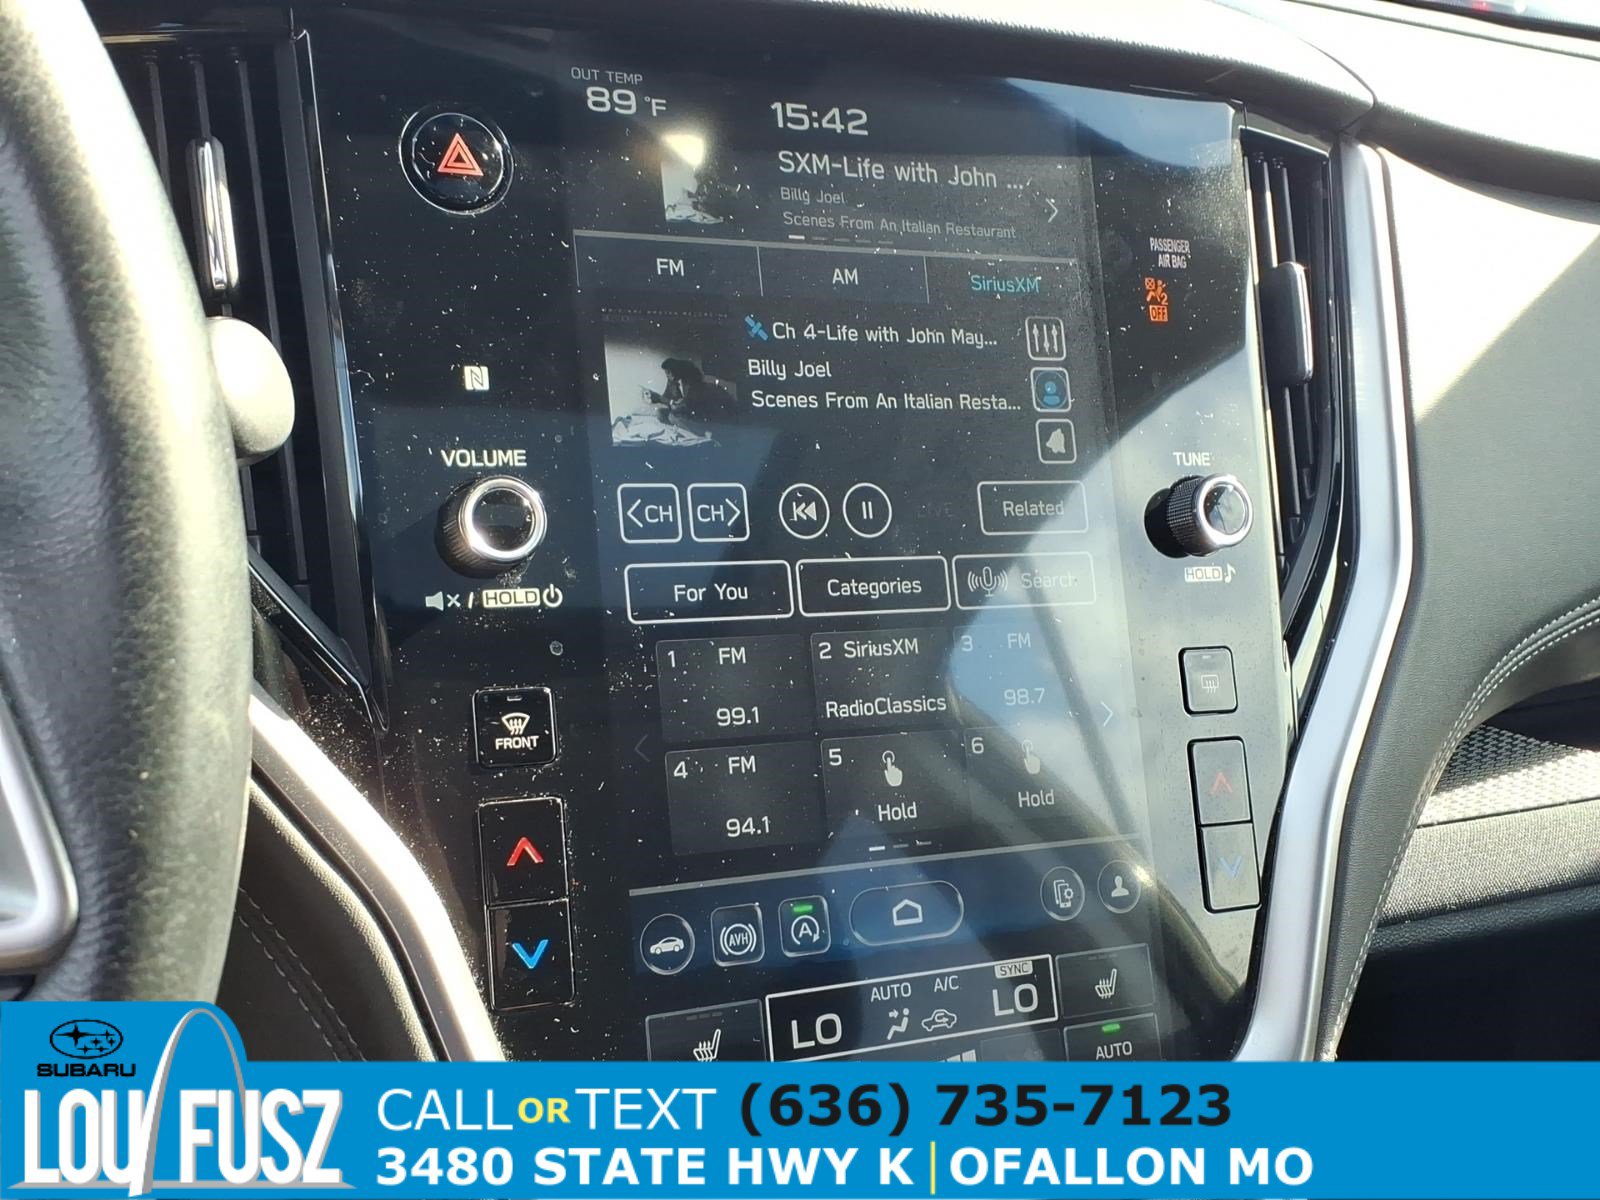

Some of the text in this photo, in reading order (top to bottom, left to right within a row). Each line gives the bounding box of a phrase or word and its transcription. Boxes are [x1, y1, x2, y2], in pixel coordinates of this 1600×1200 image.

[570, 66, 643, 85] OUT TEMP
[586, 86, 637, 115] 89
[770, 101, 869, 136] 15:42
[778, 149, 885, 181] SXM-Life
[894, 161, 938, 184] with
[947, 165, 997, 189] John
[780, 186, 846, 206] Billy Joel
[782, 211, 1016, 239] Scenes From An Italian Restaurant
[1150, 237, 1190, 253] PASSENGER
[656, 259, 684, 277] FM
[1158, 254, 1187, 269] AIR BAG
[832, 268, 858, 286] AM
[970, 274, 1039, 293] SiriusXM
[1150, 305, 1168, 321] OFF
[772, 322, 796, 341] Ch
[803, 323, 859, 343] 4-Life
[866, 325, 899, 344] with
[907, 327, 945, 345] John
[748, 359, 832, 380] Billy Joel
[751, 390, 818, 409] Scenes
[825, 391, 869, 410] From
[876, 392, 897, 410] An
[904, 392, 954, 411] Italian
[441, 450, 528, 468] VOLUME
[1173, 452, 1211, 467] TUNE
[1002, 500, 1064, 518] Related
[1186, 568, 1221, 581] HOLD
[484, 590, 538, 606] HOLD
[673, 583, 748, 602] For You
[827, 578, 922, 600] Categories
[818, 638, 919, 659] 2 SiriusXM
[960, 633, 1031, 652] 3 FM
[667, 647, 746, 669] 1 FM
[1003, 687, 1046, 706] 98.7
[716, 706, 761, 726] 99.1
[825, 695, 947, 719] RadioClassics
[495, 735, 539, 749] FRONT
[971, 737, 984, 754] 6
[828, 748, 842, 766] 5
[673, 756, 756, 779] 4 FM
[1017, 789, 1055, 809] Hold
[878, 802, 917, 822] Hold
[726, 816, 770, 837] 94.1
[729, 931, 749, 948] AVH
[1000, 962, 1029, 976] SYNC
[870, 975, 960, 1003] AUTO A/C
[992, 983, 1039, 1017] LO
[792, 1013, 842, 1049] LO
[1096, 1041, 1133, 1060] AUTO
